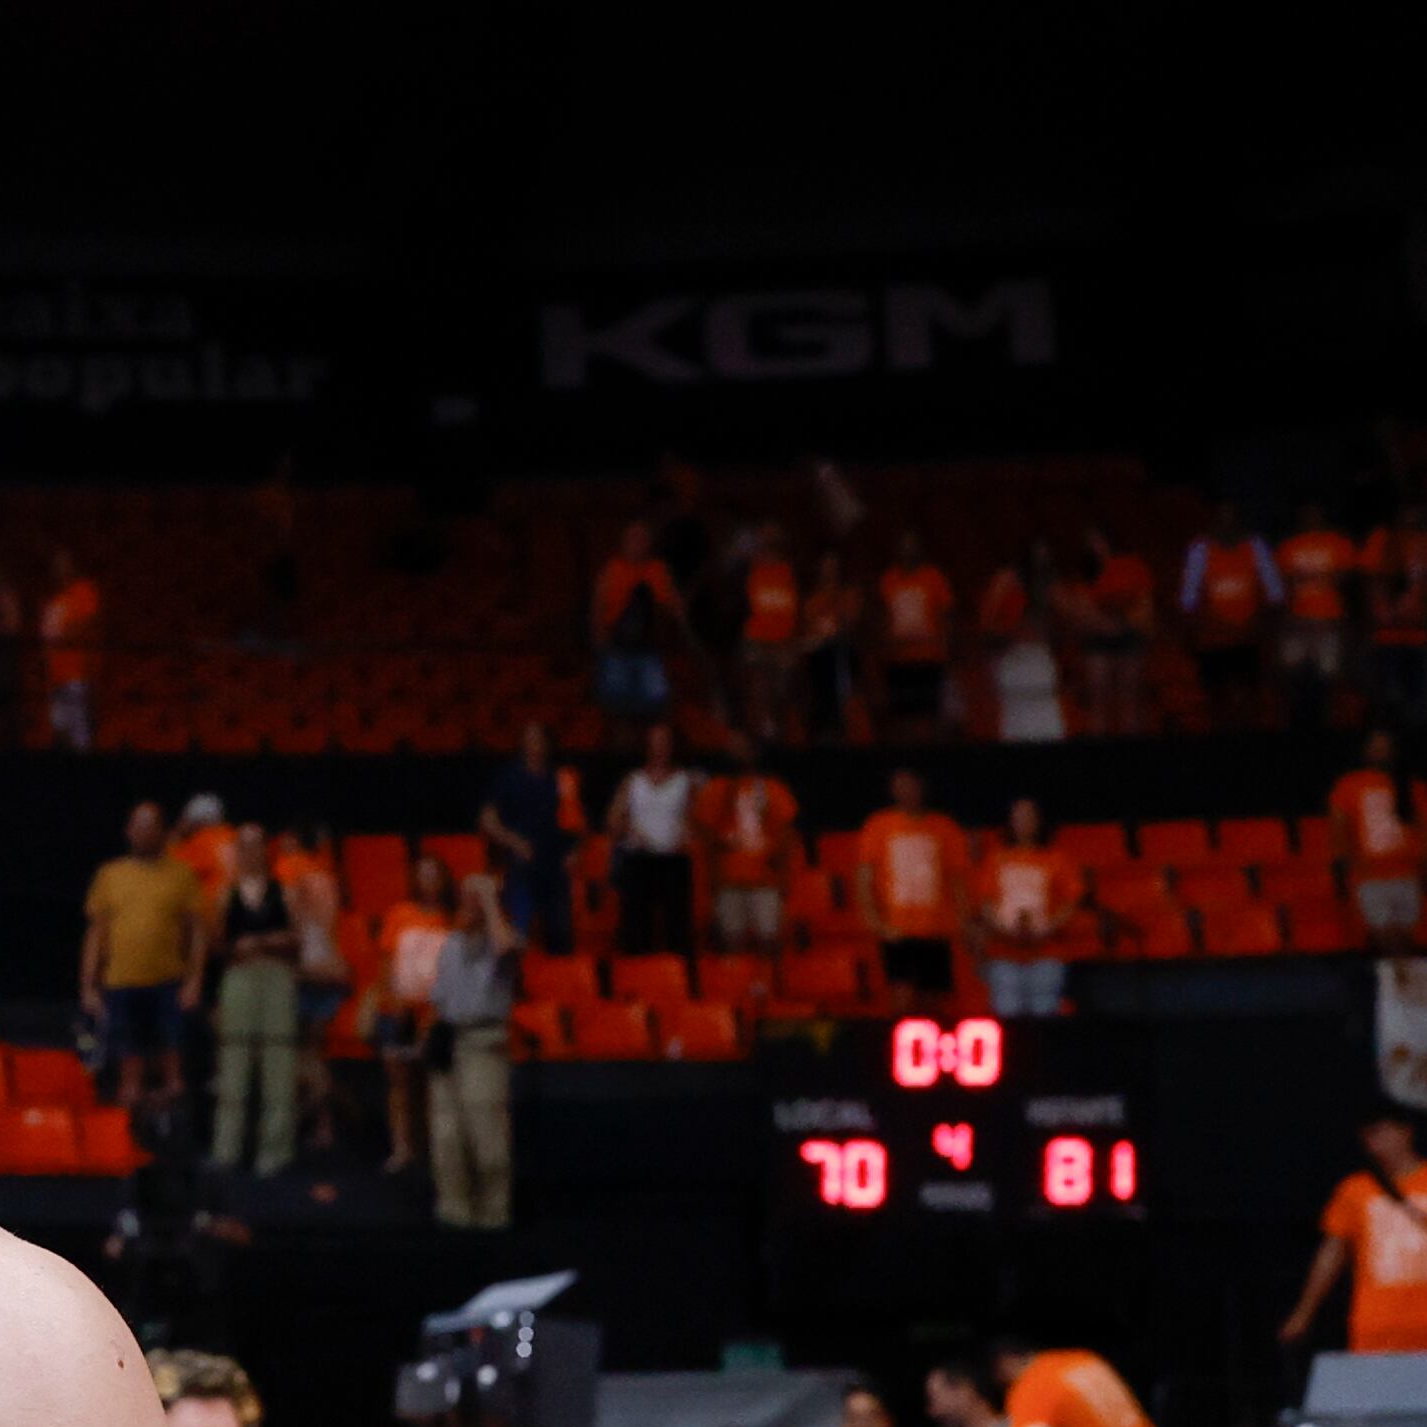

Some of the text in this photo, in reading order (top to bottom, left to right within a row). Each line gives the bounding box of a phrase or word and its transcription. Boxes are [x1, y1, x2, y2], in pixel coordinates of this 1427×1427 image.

[539, 273, 1057, 390] KGM
[893, 1017, 1002, 1087] 0:0
[800, 1138, 888, 1208] 70
[1044, 1136, 1137, 1206] 81
